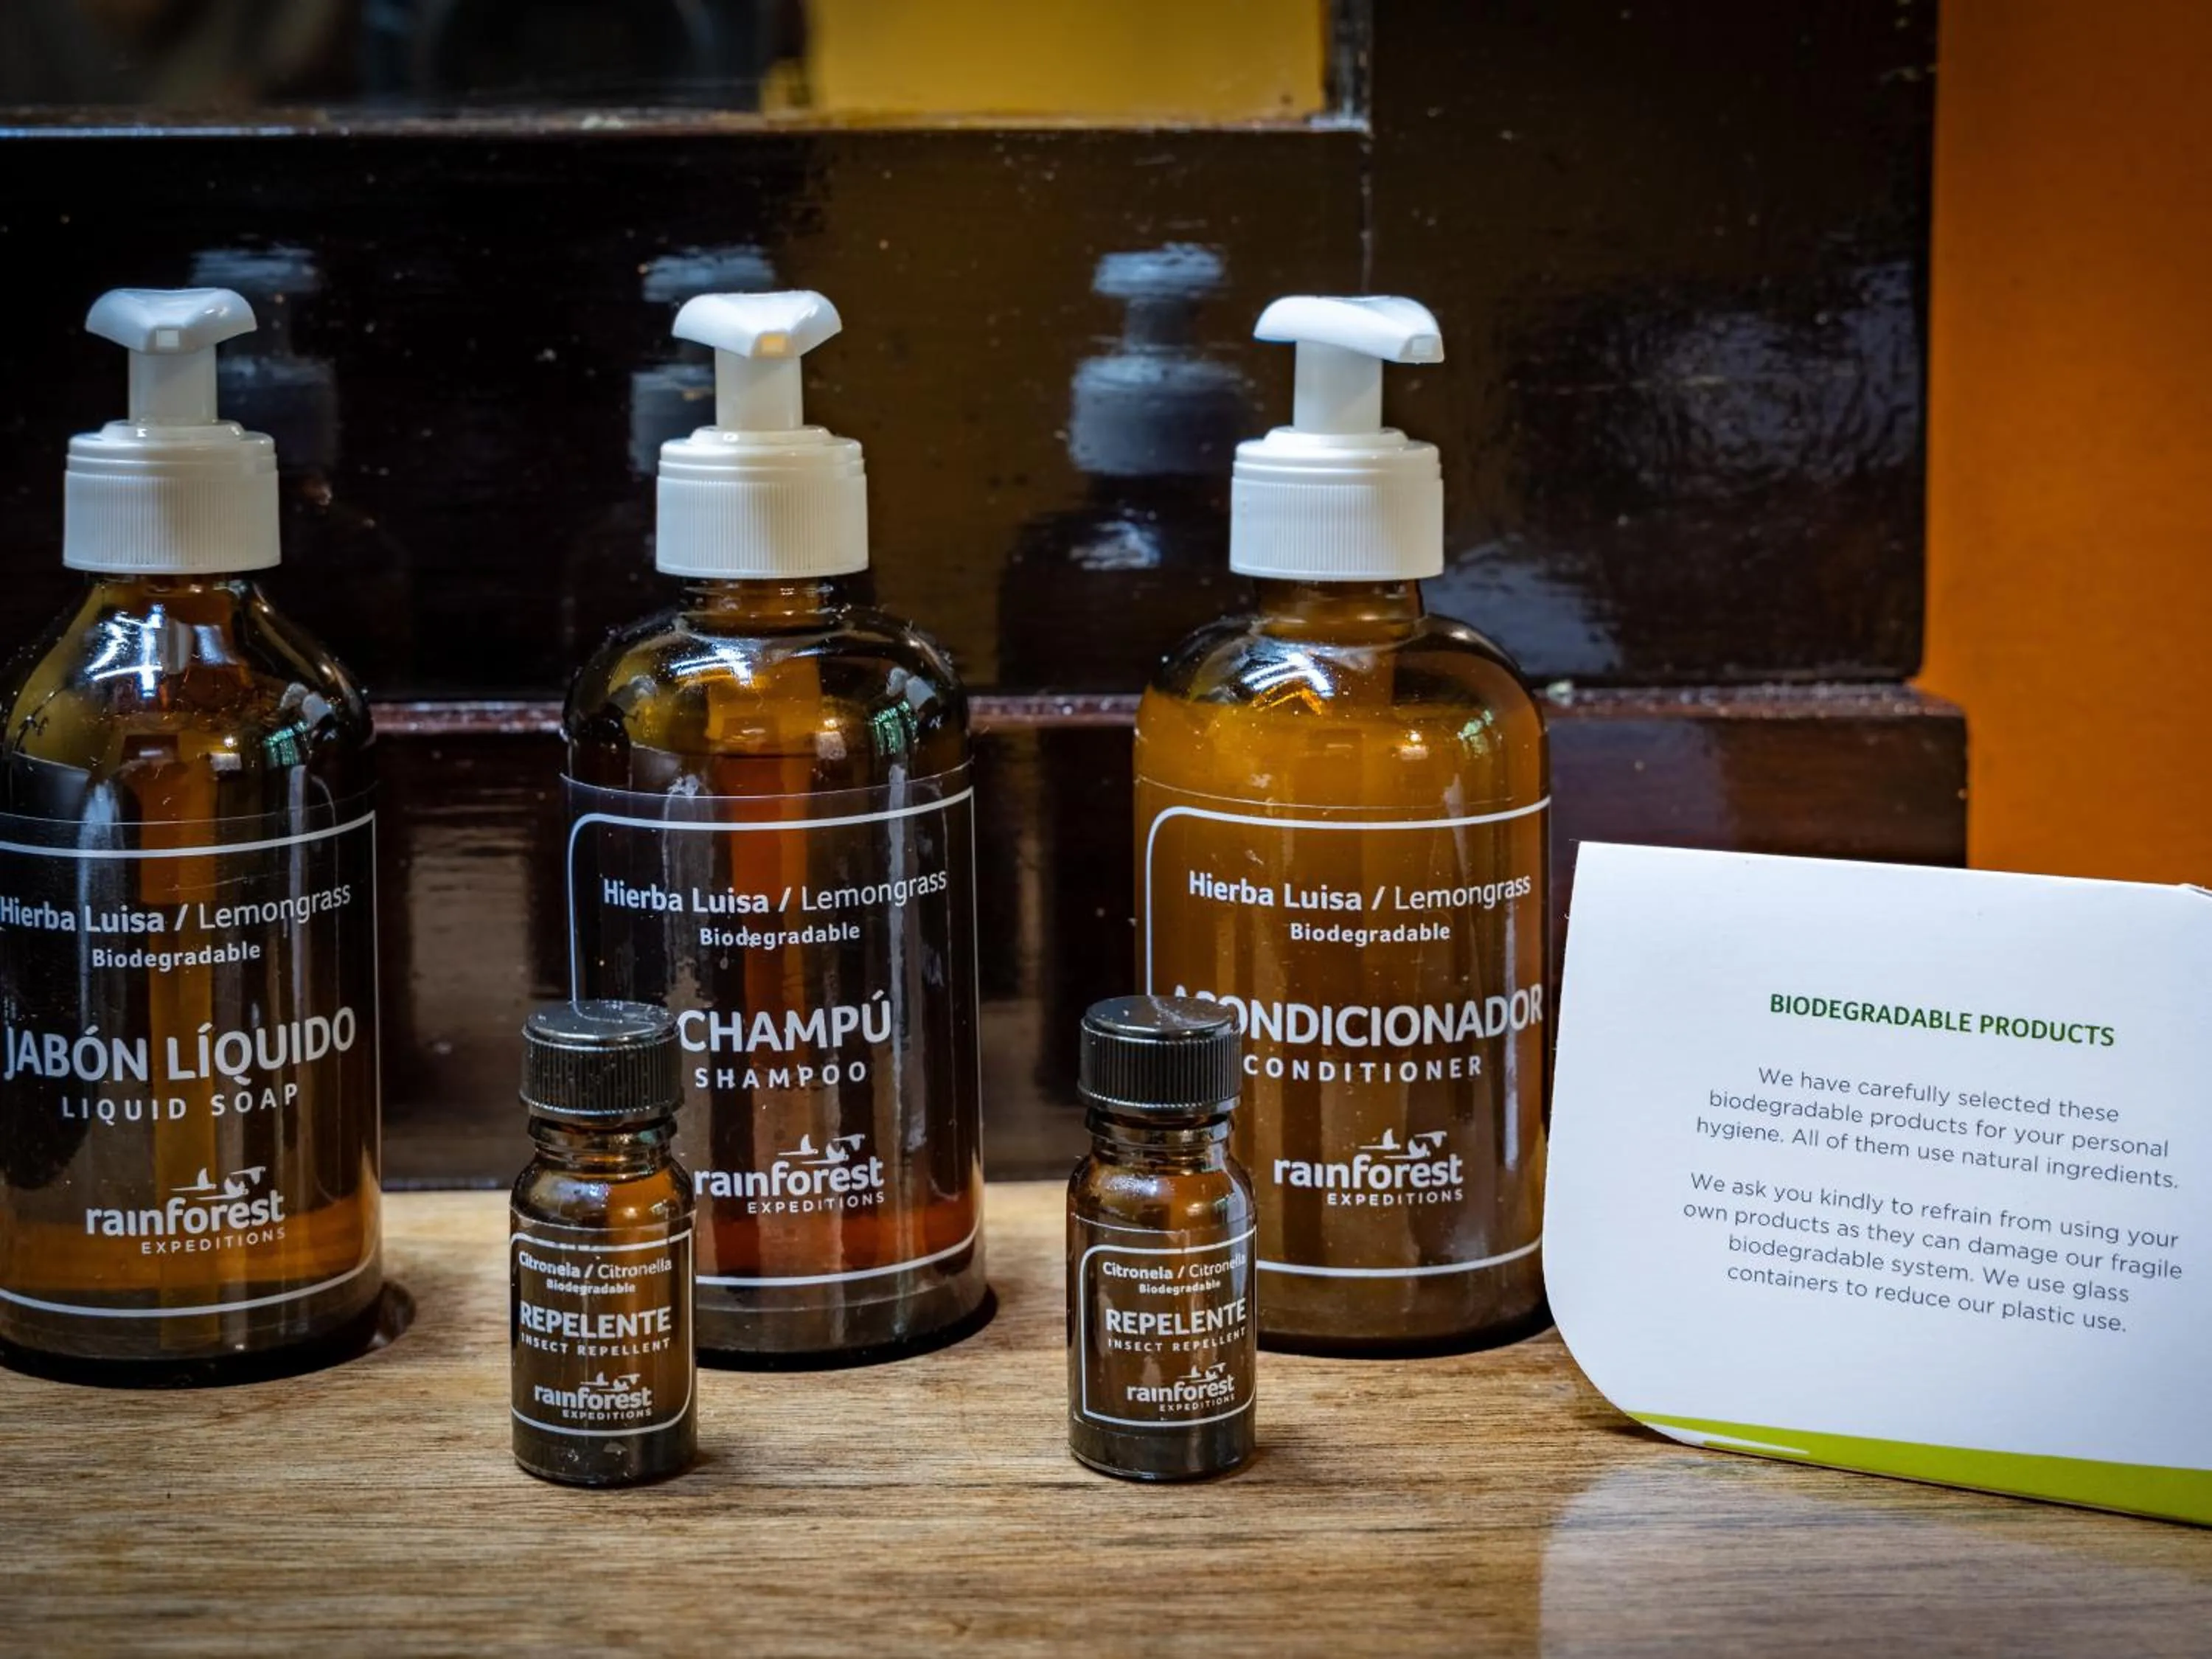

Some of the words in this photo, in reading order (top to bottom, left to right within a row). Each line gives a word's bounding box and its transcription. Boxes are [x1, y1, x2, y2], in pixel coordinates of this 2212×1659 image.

[0, 896, 76, 931] Hierba
[85, 905, 164, 933] Luisa
[174, 905, 189, 931] /
[200, 883, 351, 929] Lemongrass
[603, 879, 683, 911] Hierba
[692, 887, 769, 914] Luisa
[779, 887, 791, 912] /
[802, 871, 946, 911] Lemongrass
[1189, 871, 1273, 905] Hierba
[1284, 883, 1360, 910] Luisa
[1371, 886, 1385, 910] /
[1395, 875, 1530, 909] Lemongrass
[700, 922, 860, 950] Biodegradable
[1290, 922, 1450, 947] Biodegradable
[92, 942, 260, 972] Biodegradable
[678, 990, 891, 1052] CHAMPÚ
[1175, 984, 1543, 1047] ONDICIONADOR
[1770, 993, 1972, 1032] BIODEGRADABLE
[1980, 1015, 2115, 1046] PRODUCTS
[4, 1025, 147, 1082] JABÓN
[167, 1007, 355, 1085] LÍQUIDO
[695, 1062, 866, 1088] SHAMPOO
[1244, 1056, 1481, 1082] CONDITIONER
[62, 1097, 186, 1126] LIQUID
[211, 1083, 298, 1116] SOAP
[1759, 1067, 1793, 1086] We
[1801, 1071, 1850, 1093] have
[1859, 1081, 1950, 1107] carefully
[1958, 1091, 2050, 1115] selected
[2059, 1101, 2118, 1122] these
[1710, 1091, 1863, 1123] biodegradable
[1871, 1111, 1967, 1135] products
[1977, 1120, 2006, 1139] for
[2014, 1127, 2065, 1146] your
[2072, 1134, 2168, 1157] personal
[1274, 1152, 1463, 1189] rainforest
[1697, 1117, 1784, 1143] hygiene.
[1792, 1129, 1818, 1147] All
[1826, 1133, 1848, 1150] of
[1856, 1136, 1910, 1156] them
[1917, 1147, 1955, 1162] use
[1962, 1150, 2038, 1172] natural
[2047, 1158, 2178, 1189] ingredients.
[695, 1160, 883, 1197] rainforest
[86, 1190, 285, 1236] rainforest
[748, 1192, 884, 1214] EXPEDITIONS
[1328, 1189, 1463, 1206] EXPEDITIONS
[1691, 1172, 1725, 1192] We
[1732, 1180, 1767, 1198] ask
[1774, 1186, 1812, 1203] you
[1820, 1188, 1883, 1214] kindly
[1892, 1197, 1913, 1216] to
[1921, 1203, 1991, 1225] refrain
[2000, 1210, 2051, 1233] from
[2060, 1220, 2118, 1244] using
[2128, 1229, 2179, 1248] your
[141, 1228, 285, 1254] EXPEDITIONS
[1684, 1203, 1727, 1222] own
[1735, 1210, 1829, 1234] products
[1837, 1222, 1859, 1238] as
[1868, 1224, 1915, 1248] they
[1922, 1234, 1960, 1251] can
[1968, 1237, 2058, 1265] damage
[2066, 1252, 2103, 1268] our
[2112, 1253, 2183, 1280] fragile
[518, 1252, 580, 1278] Citronela
[598, 1259, 672, 1279] Citronella
[1103, 1262, 1173, 1279] Citronela
[1189, 1253, 1245, 1277] Citronella
[1729, 1234, 1884, 1270] biodegradable
[1891, 1257, 1974, 1282] system.
[1983, 1267, 2019, 1287] We
[2028, 1277, 2065, 1294] use
[2073, 1281, 2129, 1303] glass
[546, 1279, 635, 1295] Biodegradable
[1139, 1279, 1221, 1295] Biodegradable
[1728, 1267, 1838, 1293] containers
[1846, 1279, 1868, 1297] to
[1875, 1285, 1950, 1309] reduce
[1958, 1297, 1994, 1313] our
[2002, 1301, 2075, 1326] plastic
[2083, 1314, 2126, 1332] use.
[520, 1300, 671, 1339] REPELENTE
[1106, 1298, 1246, 1335] REPELENTE
[521, 1332, 568, 1352] INSECT
[577, 1338, 669, 1356] REPELLENT
[1108, 1338, 1163, 1352] INSECT
[1172, 1327, 1245, 1352] REPELLENT
[535, 1385, 652, 1410] rainforest
[1127, 1374, 1234, 1402] rainforest
[1160, 1394, 1234, 1411] EXPEDITIONS
[563, 1408, 652, 1420] EXPEDITIONS
